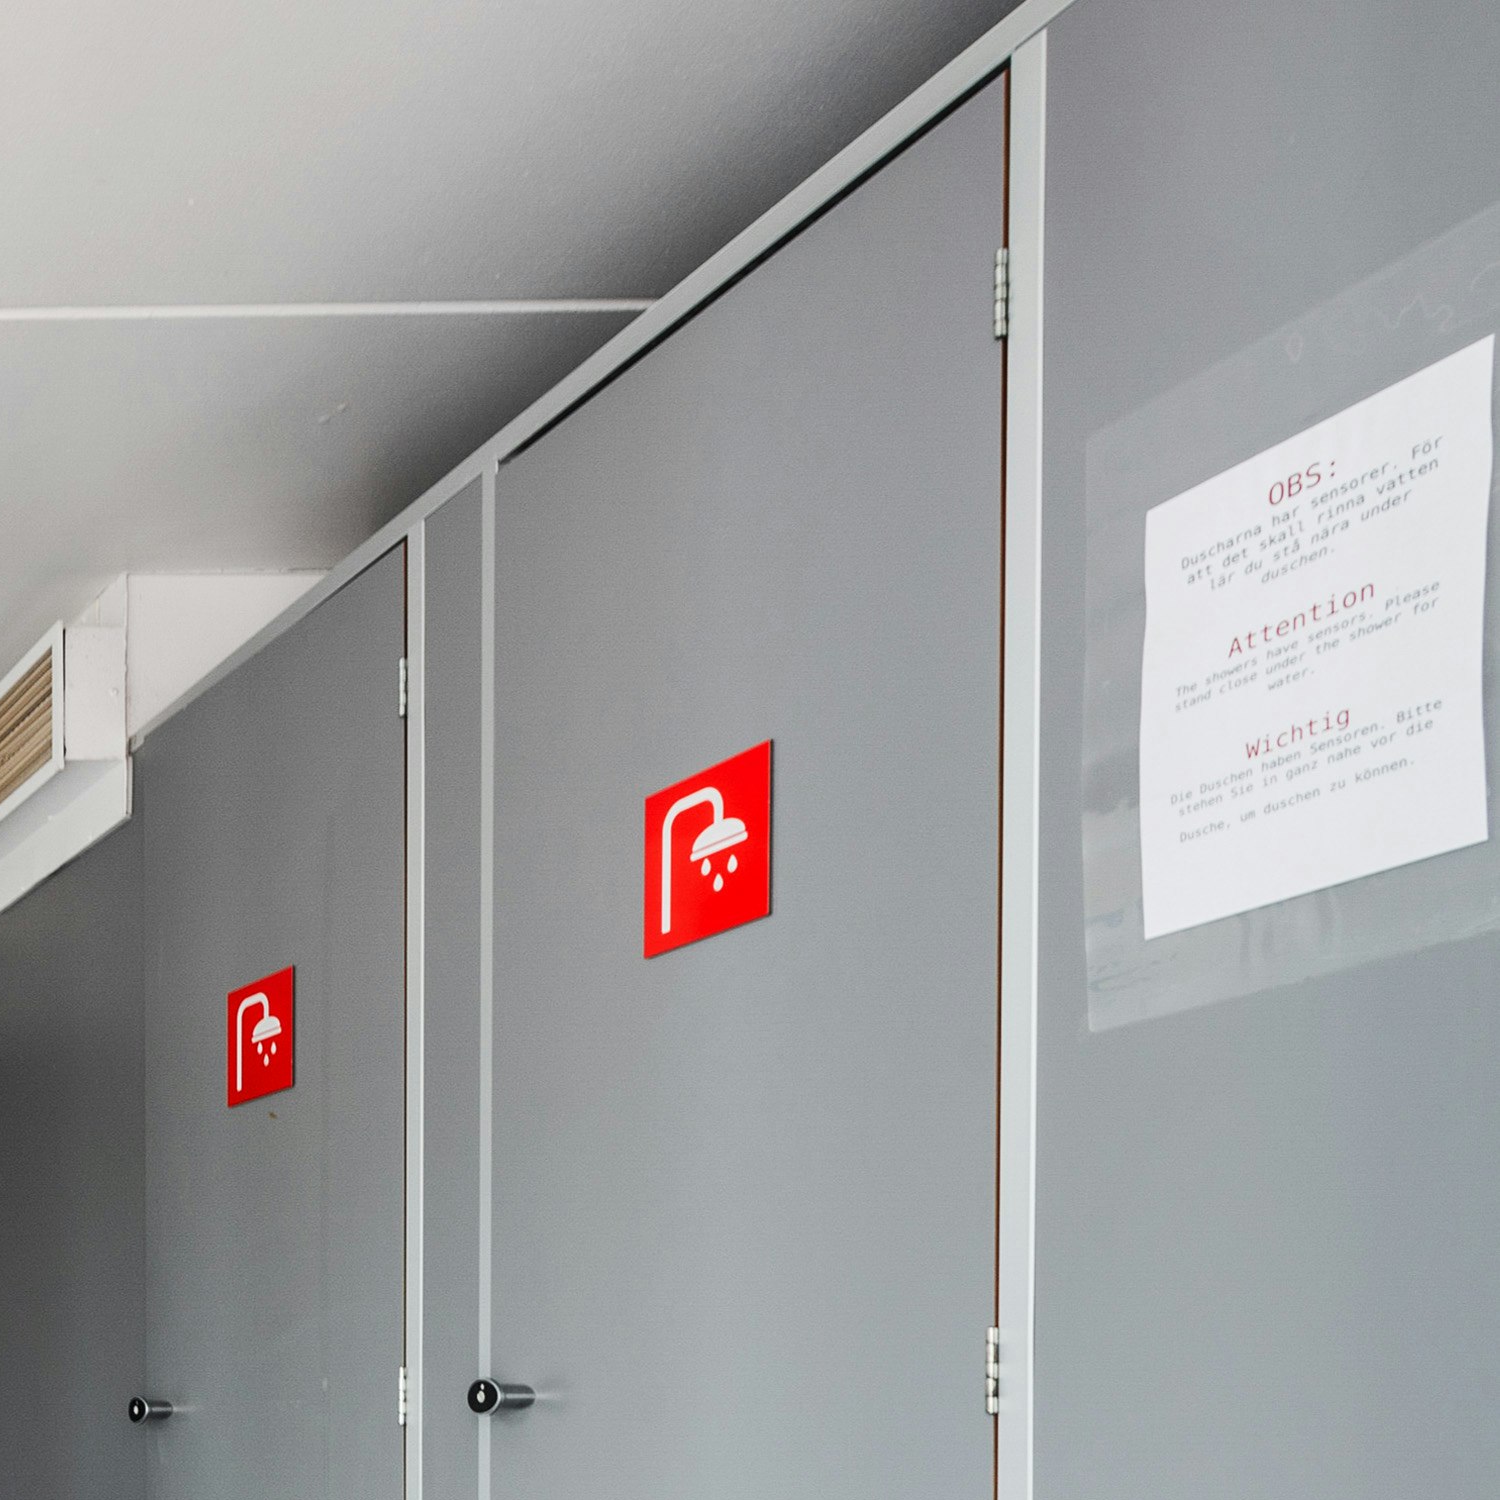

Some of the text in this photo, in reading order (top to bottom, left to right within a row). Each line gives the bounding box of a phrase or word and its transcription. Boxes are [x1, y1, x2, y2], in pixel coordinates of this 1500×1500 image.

[1180, 435, 1444, 570] Duscharna har sensorer. För
[1187, 454, 1439, 585] att det skall rinna vatten
[1267, 459, 1336, 506] OBS:
[1244, 559, 1263, 576] du
[1272, 537, 1301, 563] stå
[1310, 519, 1350, 545] nära
[1360, 488, 1413, 522] under
[1260, 546, 1336, 584] duschen.
[1175, 596, 1439, 713] stand close under the shower for
[1176, 681, 1198, 697] The
[1205, 656, 1258, 685] showers
[1266, 640, 1299, 660] have
[1308, 611, 1374, 642] sensors.
[1228, 582, 1375, 658] Attention
[1267, 667, 1315, 692] water.
[1170, 698, 1443, 805] Die Duschen haben Sensoren. Bitte
[1178, 718, 1434, 817] stehen Sie in ganz nahe vor die
[1244, 706, 1351, 760] Wichtig
[1239, 809, 1257, 823] um
[1264, 786, 1321, 815] duschen
[1329, 777, 1347, 793] zu
